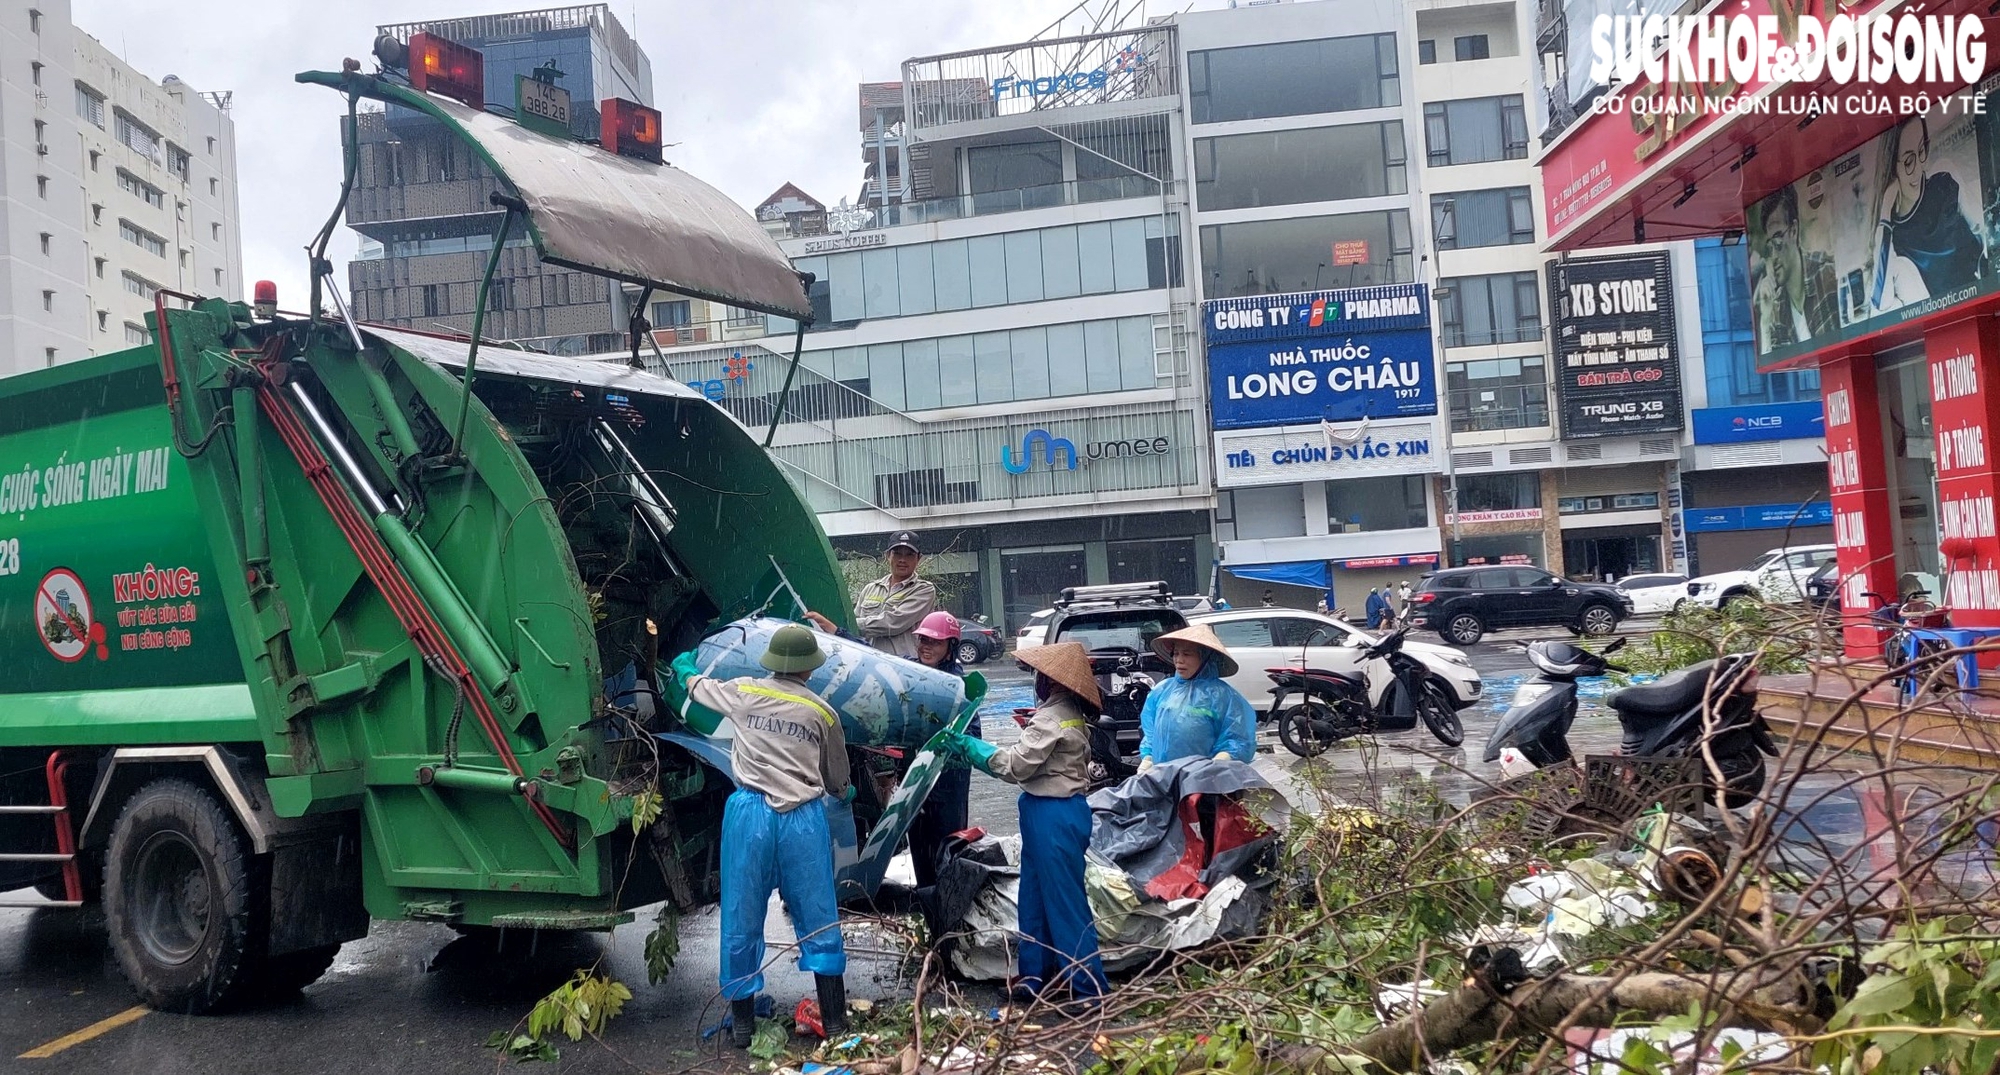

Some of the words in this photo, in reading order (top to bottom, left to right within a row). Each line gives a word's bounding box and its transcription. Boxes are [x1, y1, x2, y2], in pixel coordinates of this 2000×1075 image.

[536, 83, 556, 102] 14C
[993, 68, 1108, 101] Finance
[527, 96, 566, 120] 388.28
[1570, 283, 1596, 317] XB
[1599, 279, 1657, 315] STORE
[1900, 284, 1978, 320] www.lidooptic.com
[1215, 307, 1264, 330] CÔNG
[1269, 307, 1290, 326] TY
[1299, 305, 1338, 322] FPT
[1345, 296, 1421, 320] PHARMA
[1270, 347, 1307, 366] NHÀ
[1310, 338, 1370, 363] THUỐC
[1567, 351, 1582, 367] MÁY
[1584, 350, 1599, 366] TÍNH
[1636, 347, 1658, 361] THANH
[1659, 342, 1669, 359] SỐ
[1227, 370, 1317, 400] LONG
[1328, 357, 1420, 392] CHÂU
[1577, 371, 1606, 386] BÁN
[1633, 367, 1662, 383] GÓP
[1932, 361, 1947, 401] ĐA
[1945, 347, 1978, 399] TRÒNG
[1394, 389, 1421, 399] 1917
[1581, 403, 1636, 416] TRUNG
[1640, 401, 1663, 412] XB
[1748, 416, 1782, 426] NCB
[1086, 436, 1169, 460] umee
[1226, 450, 1255, 468] TIÊ
[1395, 440, 1429, 457] XIN
[1939, 424, 1951, 471] ÁP
[1952, 419, 1985, 469] TRÒNG
[0, 463, 40, 521] CUỘC
[42, 450, 86, 508] SỐNG
[88, 446, 133, 500] NGÀY
[135, 447, 169, 493] MAI
[0, 538, 20, 575] 28
[113, 562, 200, 603] KHÔNG:
[138, 605, 157, 626] RÁC
[157, 603, 179, 625] BỪA
[139, 628, 164, 649] CÔNG
[165, 626, 191, 652] CỘNG
[746, 712, 785, 734] TUẤN
